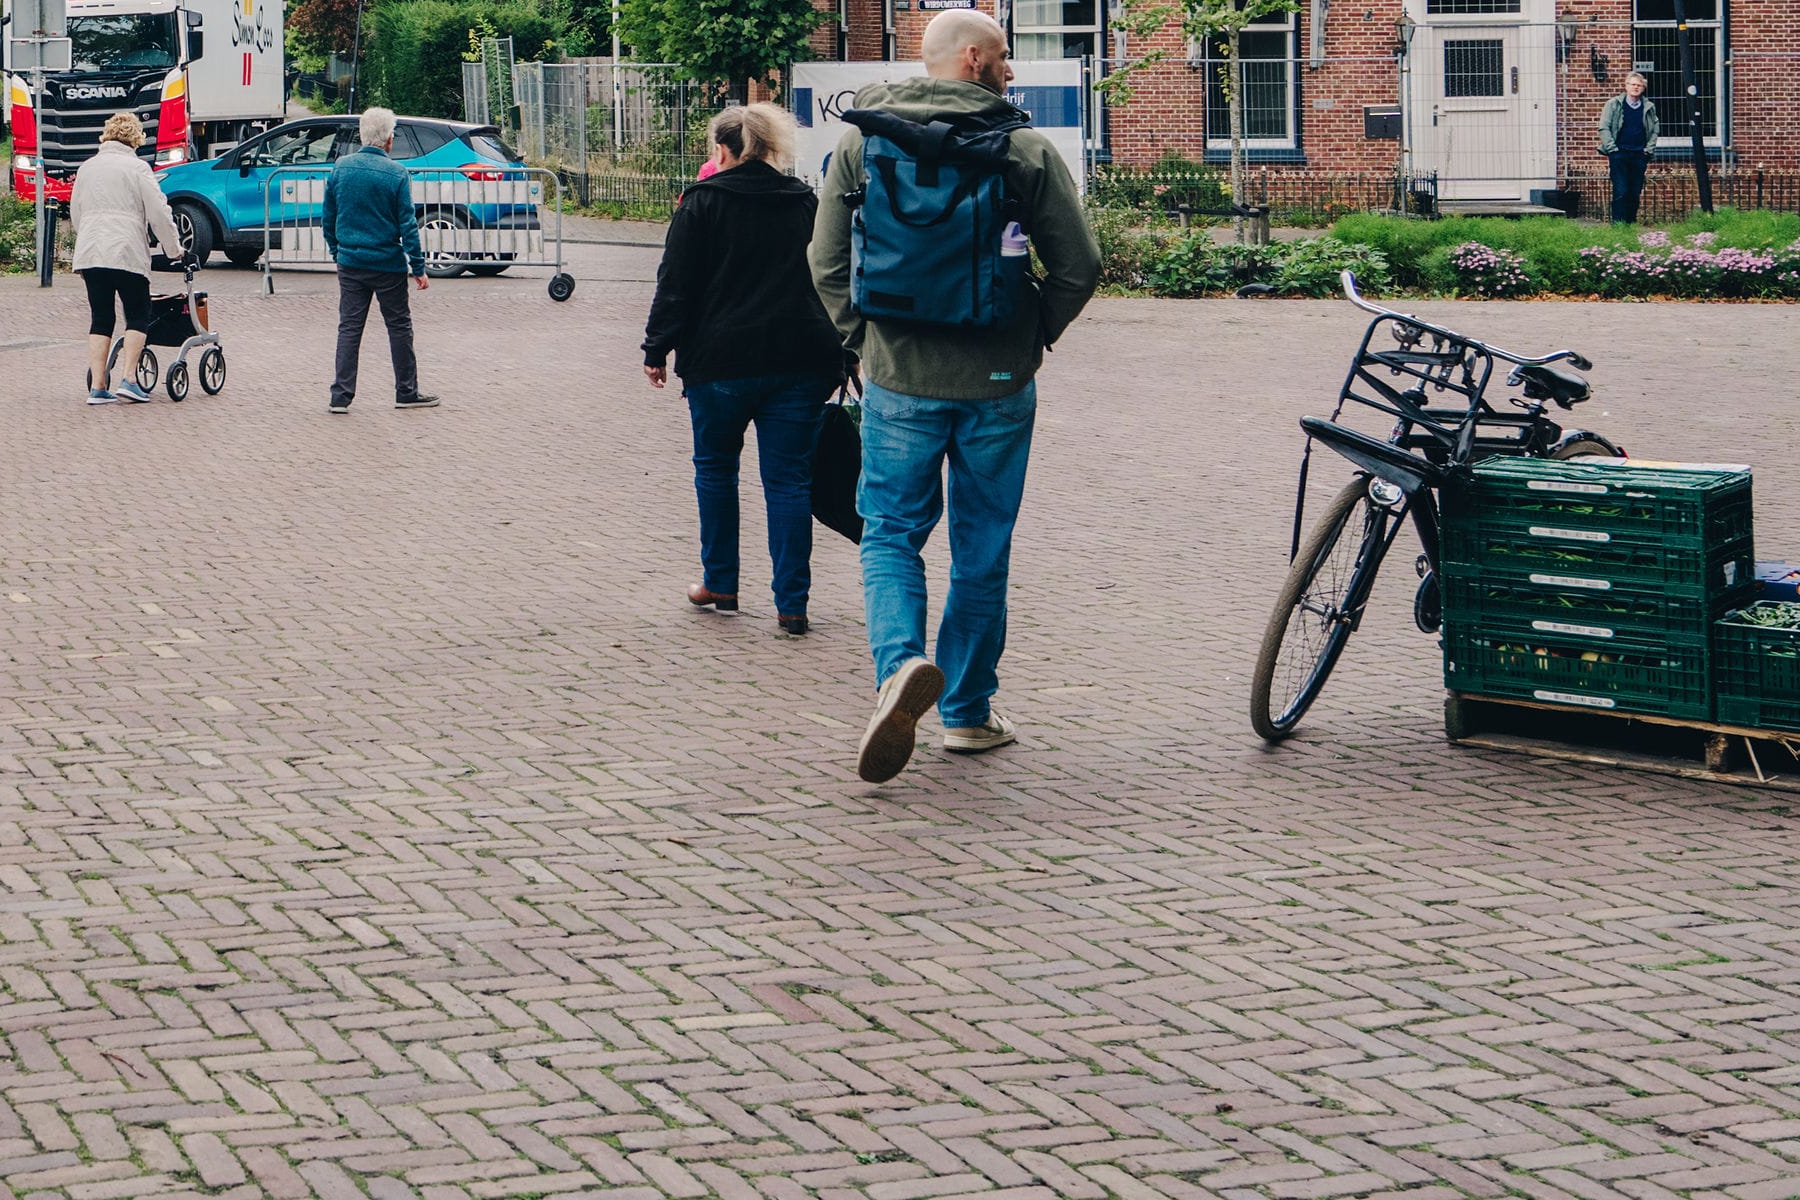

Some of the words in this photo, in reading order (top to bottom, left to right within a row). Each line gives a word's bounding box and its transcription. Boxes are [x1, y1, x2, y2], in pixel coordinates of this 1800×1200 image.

[232, 0, 255, 47] Simon
[255, 4, 273, 54] Loos
[65, 86, 127, 100] SCANIA
